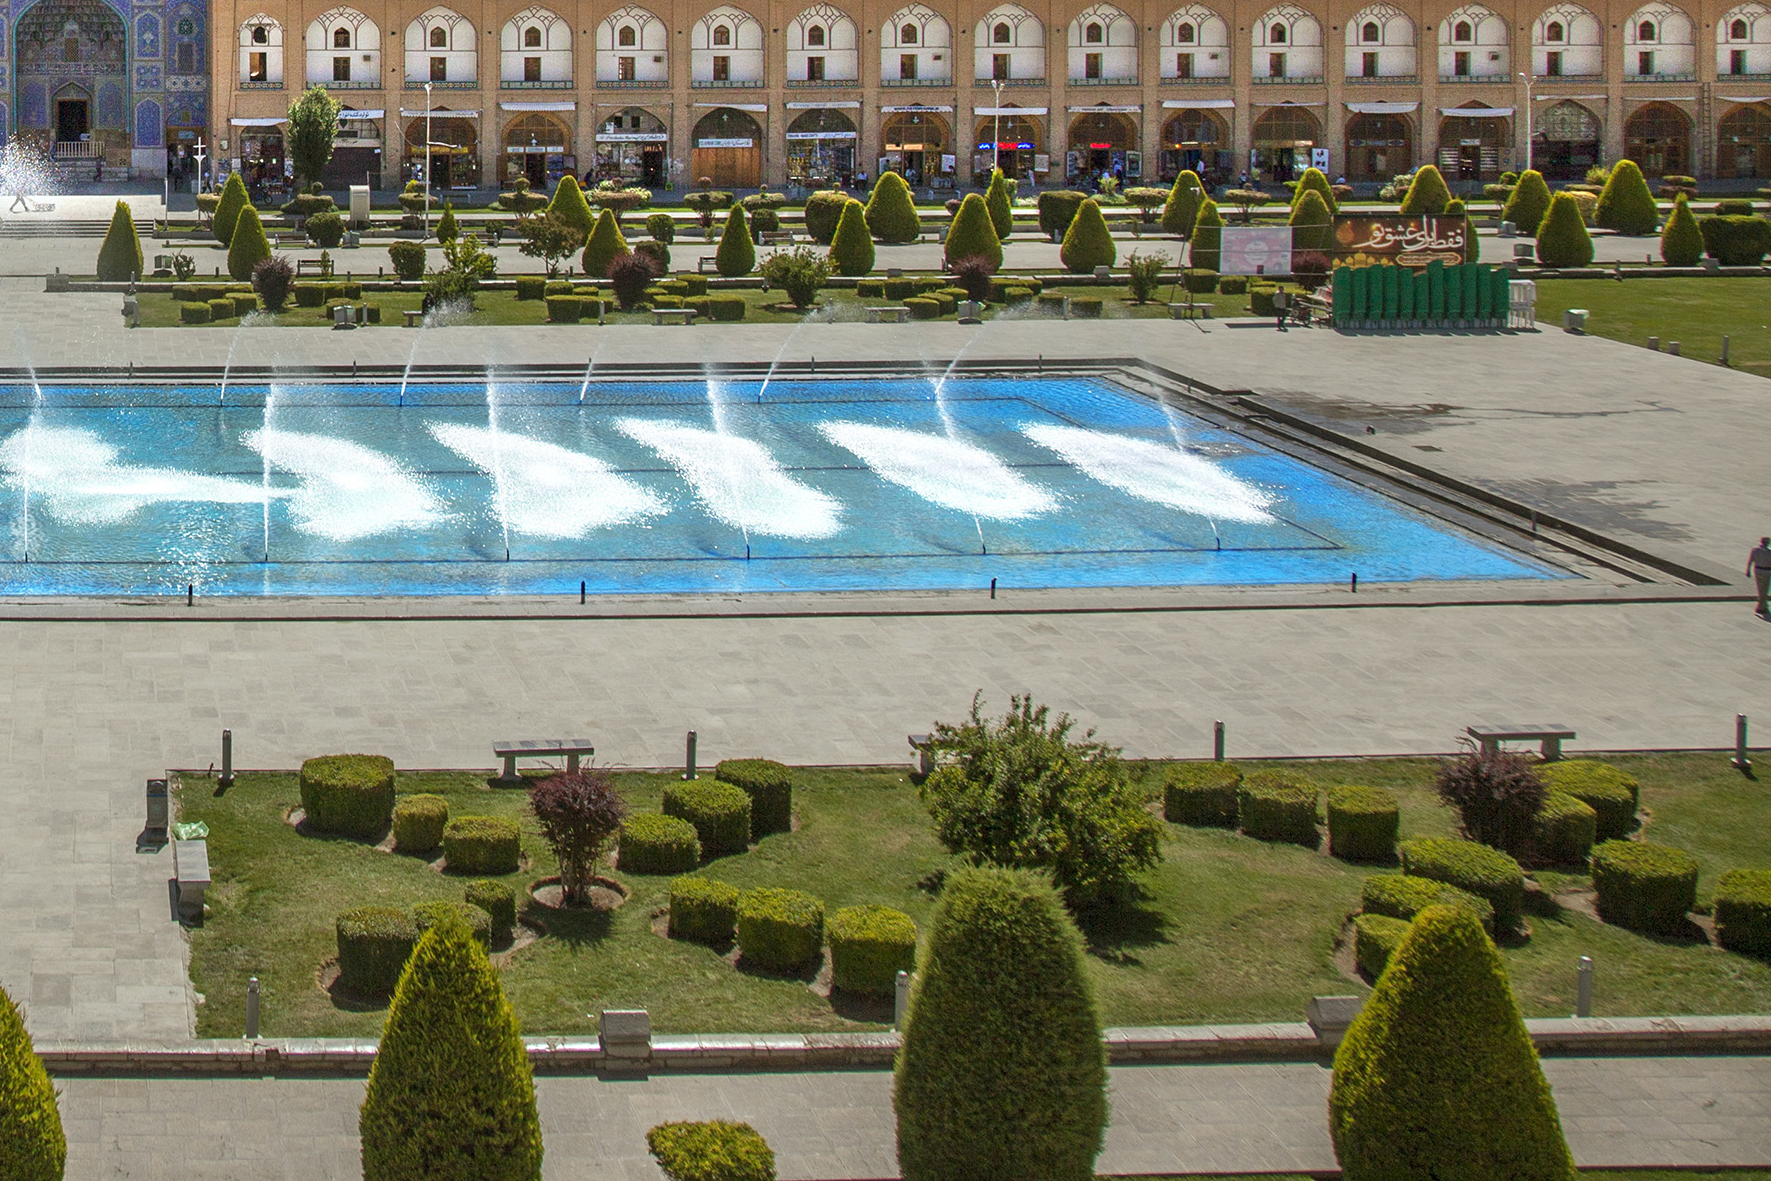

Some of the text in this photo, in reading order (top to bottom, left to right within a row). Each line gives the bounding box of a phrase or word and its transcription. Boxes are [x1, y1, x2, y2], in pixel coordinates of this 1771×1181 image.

[1352, 214, 1464, 252] فقط برای عشق تو
